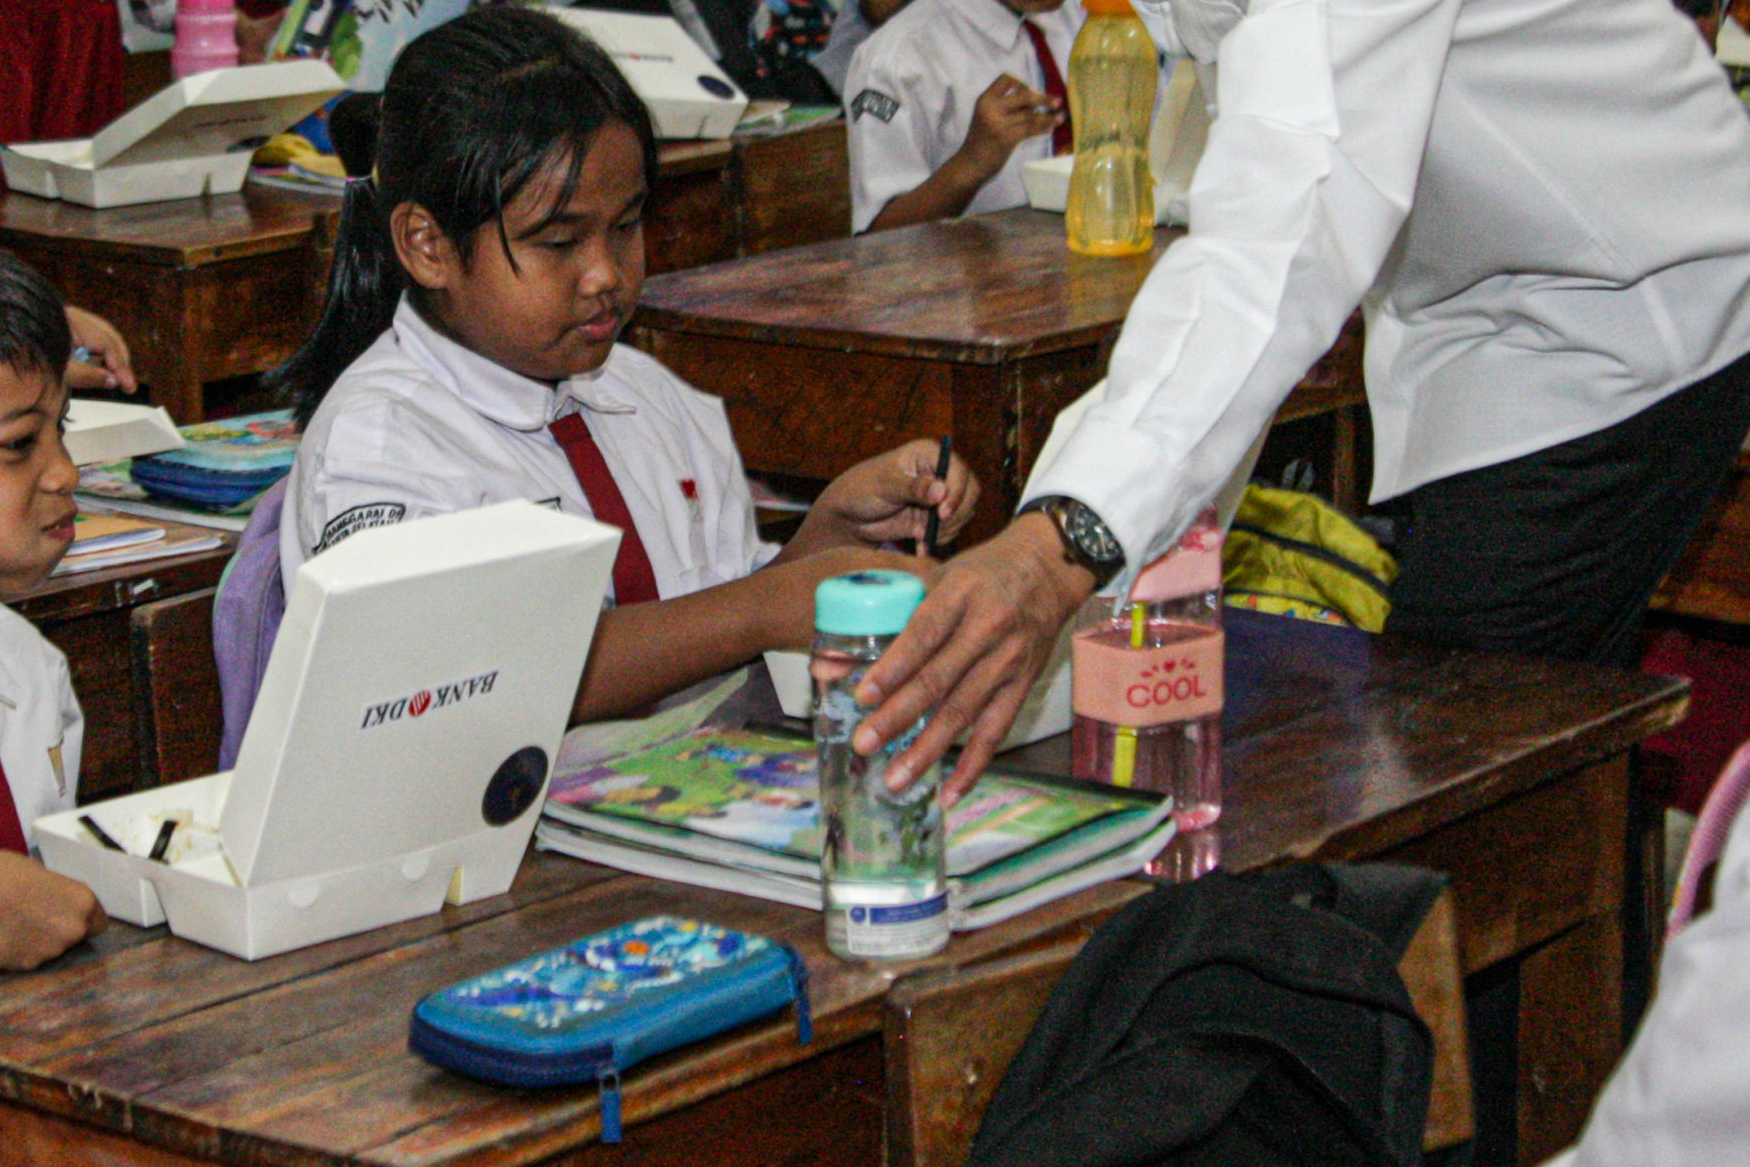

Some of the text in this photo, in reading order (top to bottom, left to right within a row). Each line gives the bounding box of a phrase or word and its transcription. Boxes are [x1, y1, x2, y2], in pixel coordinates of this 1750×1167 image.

[360, 669, 499, 730] BANK DKI
[1126, 675, 1206, 709] COOL
